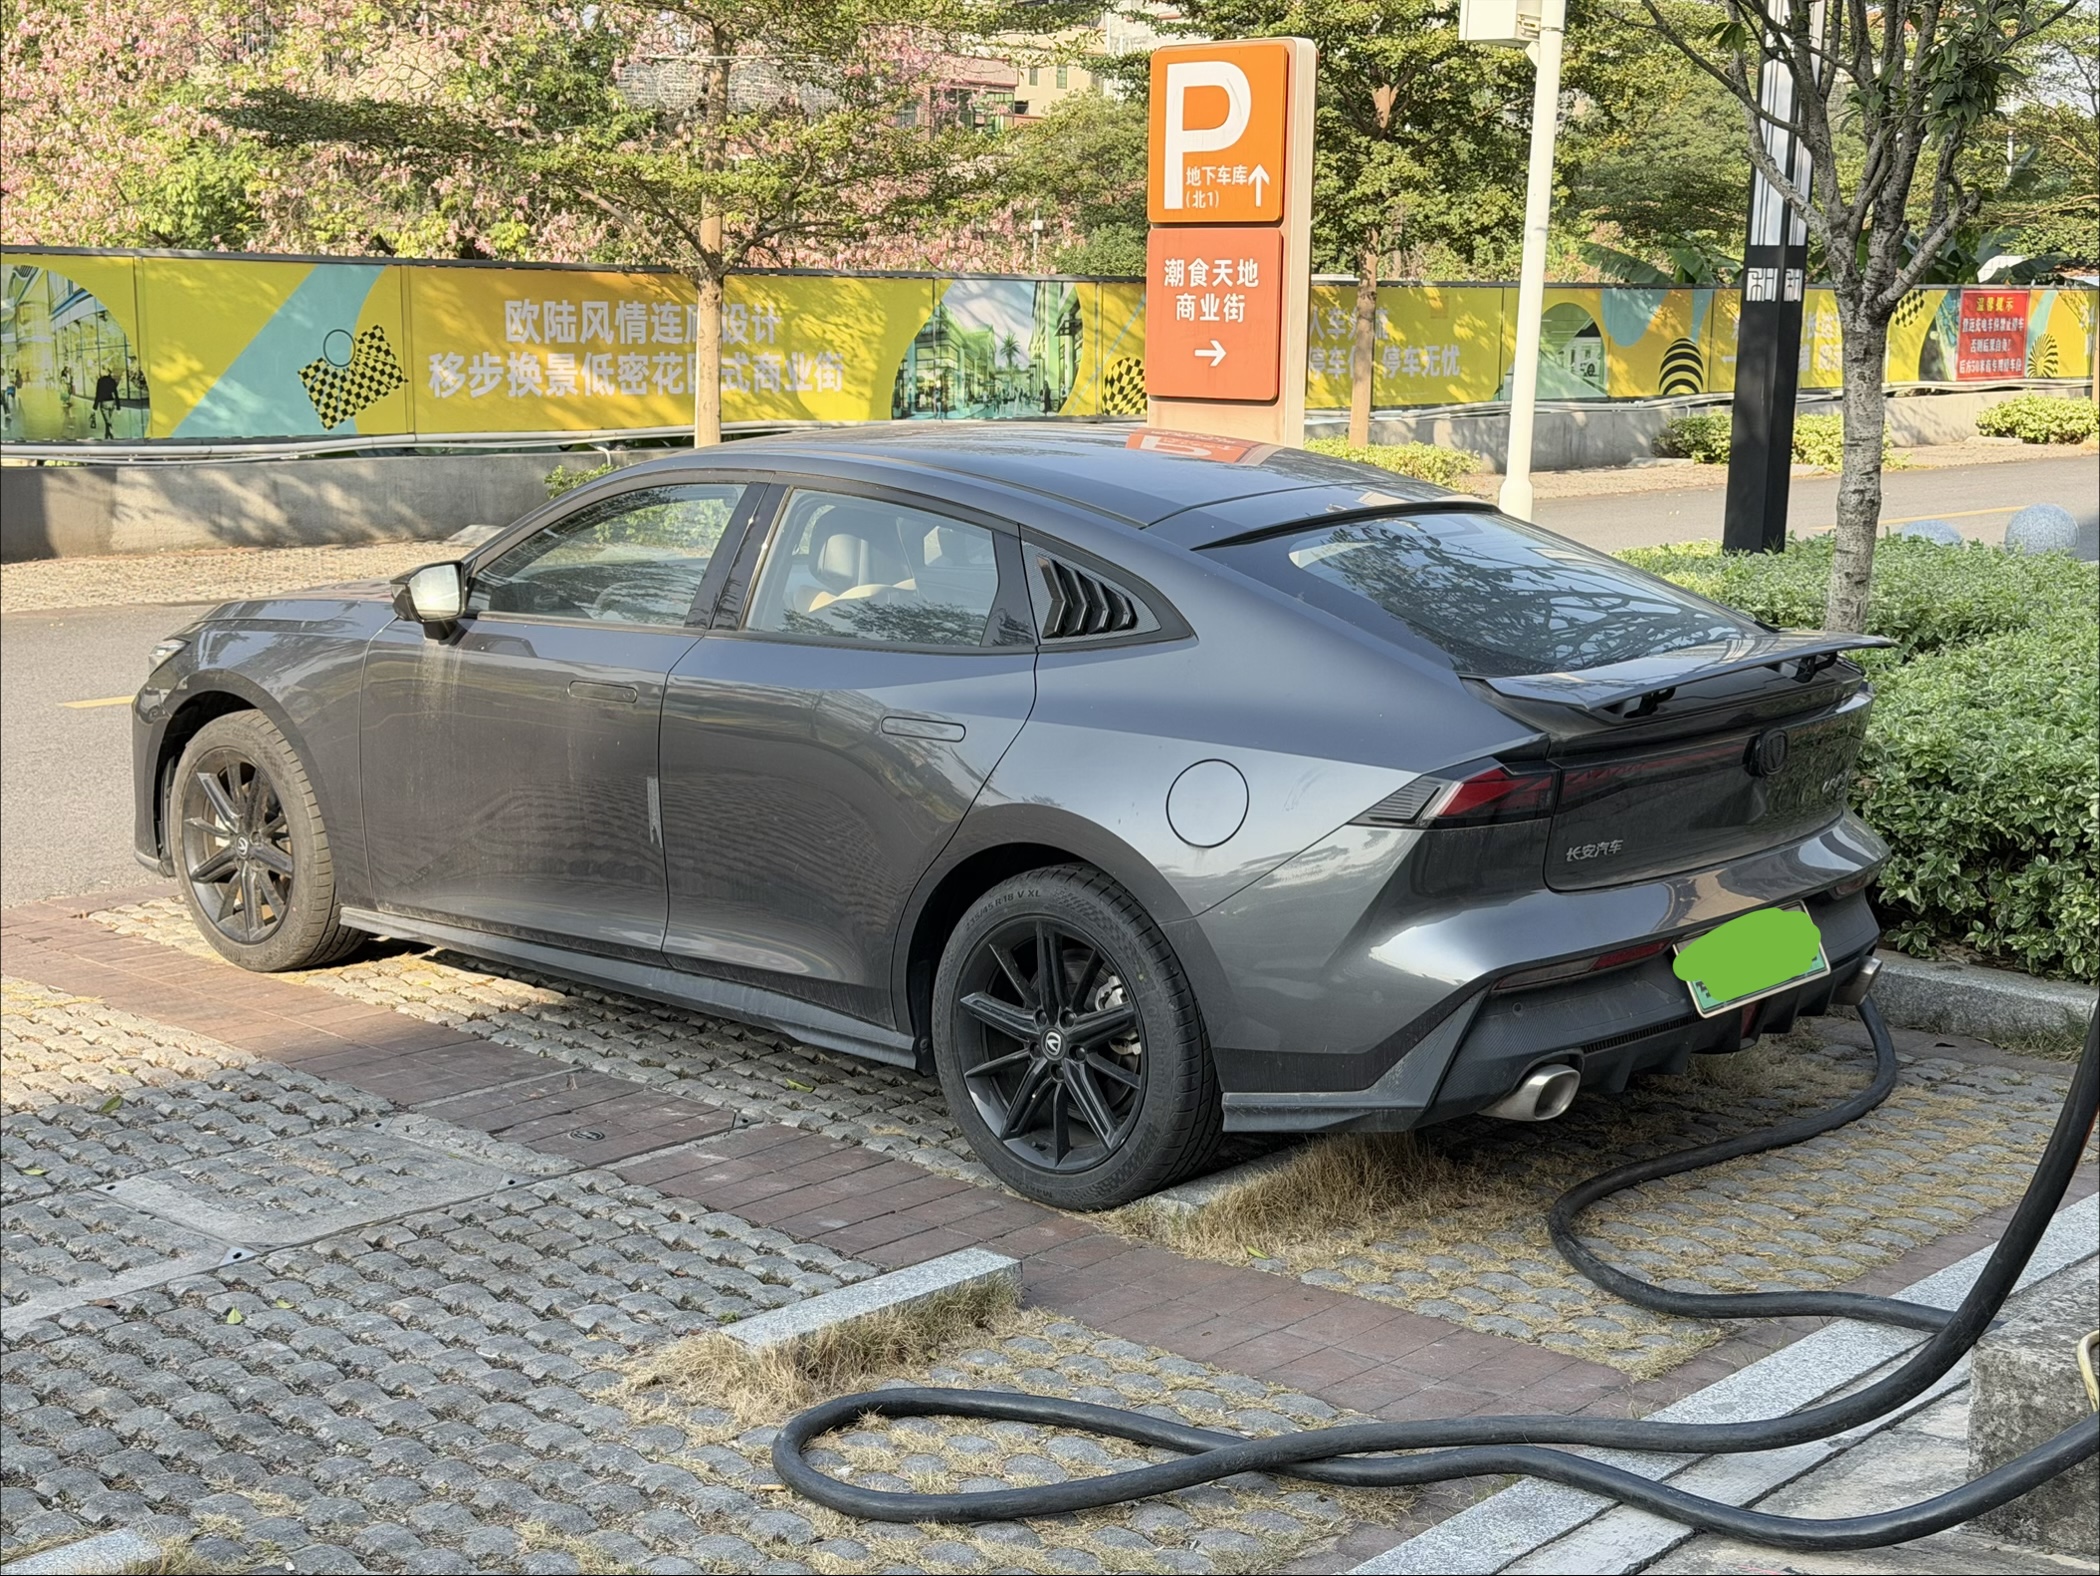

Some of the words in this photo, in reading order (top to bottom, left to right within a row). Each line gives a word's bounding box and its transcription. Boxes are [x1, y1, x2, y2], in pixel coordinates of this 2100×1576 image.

[1164, 61, 1252, 210] P
[1185, 165, 1248, 187] 地下车库
[1185, 190, 1219, 209] (北1)
[1163, 258, 1259, 288] 潮食天地
[1175, 293, 1246, 323] 商业街
[1382, 344, 1460, 379] 停车无忧
[1565, 839, 1624, 862] 长安汽车
